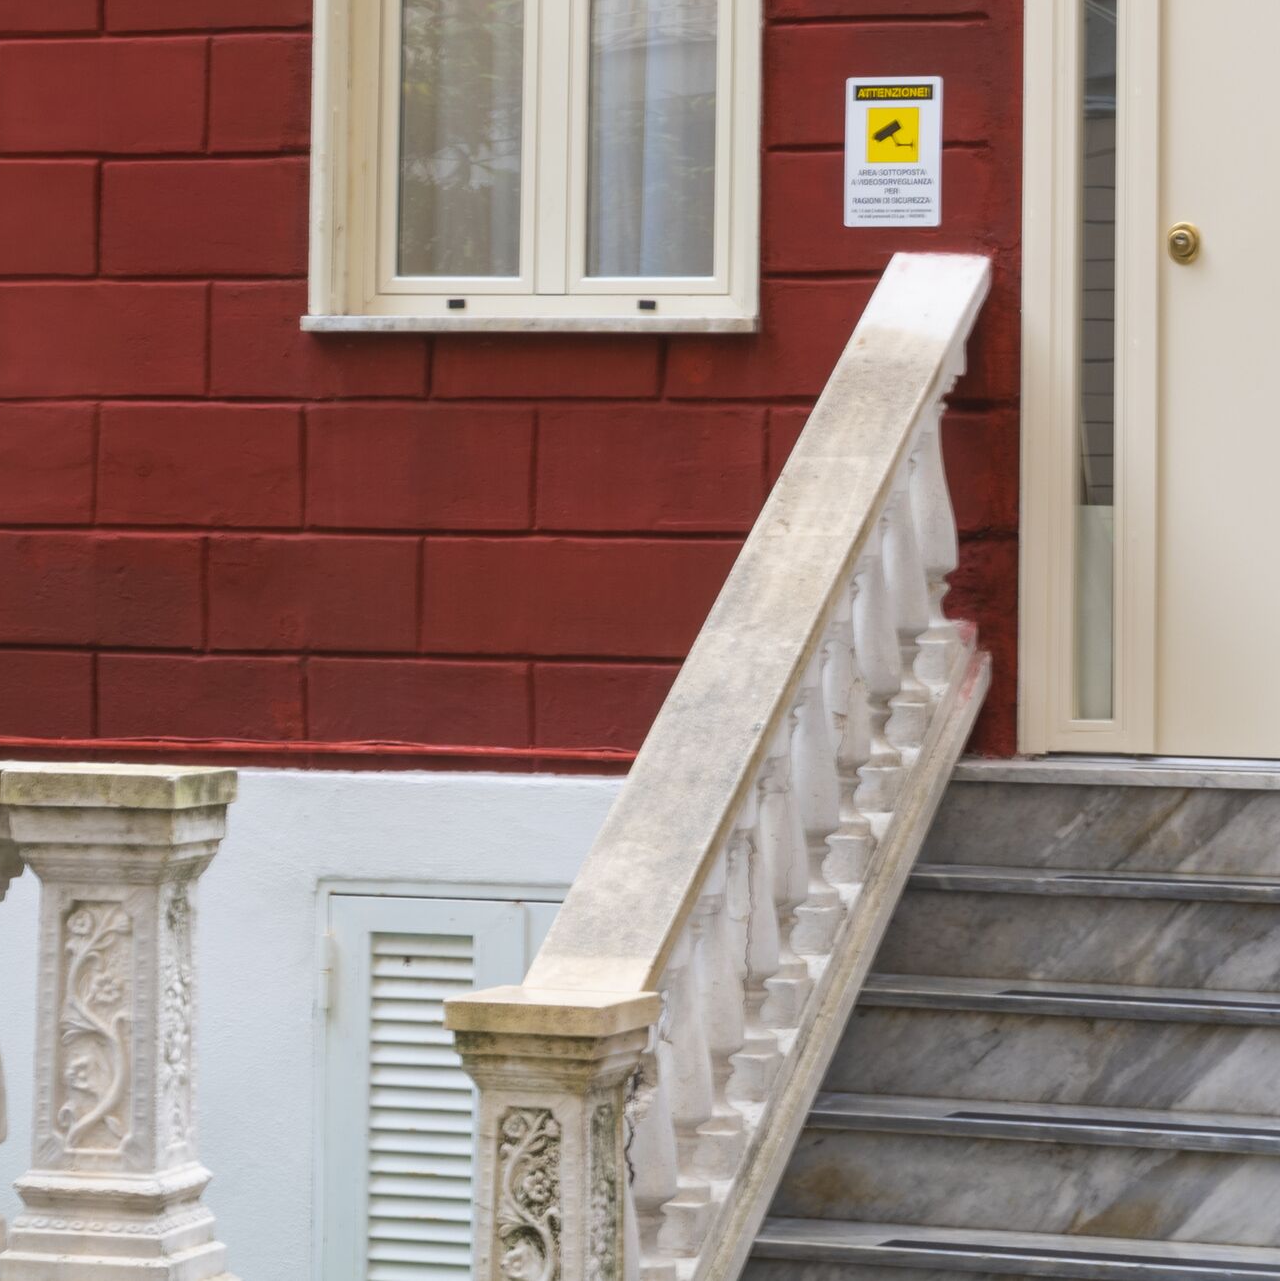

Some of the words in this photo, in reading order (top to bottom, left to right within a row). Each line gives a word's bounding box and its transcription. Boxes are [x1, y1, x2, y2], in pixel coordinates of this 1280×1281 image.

[857, 87, 928, 98] ATTENZIONE!
[858, 169, 878, 177] AREA
[879, 168, 926, 176] SOTTOPOSTA
[858, 178, 932, 186] VIDEOSORVEGLIANZA
